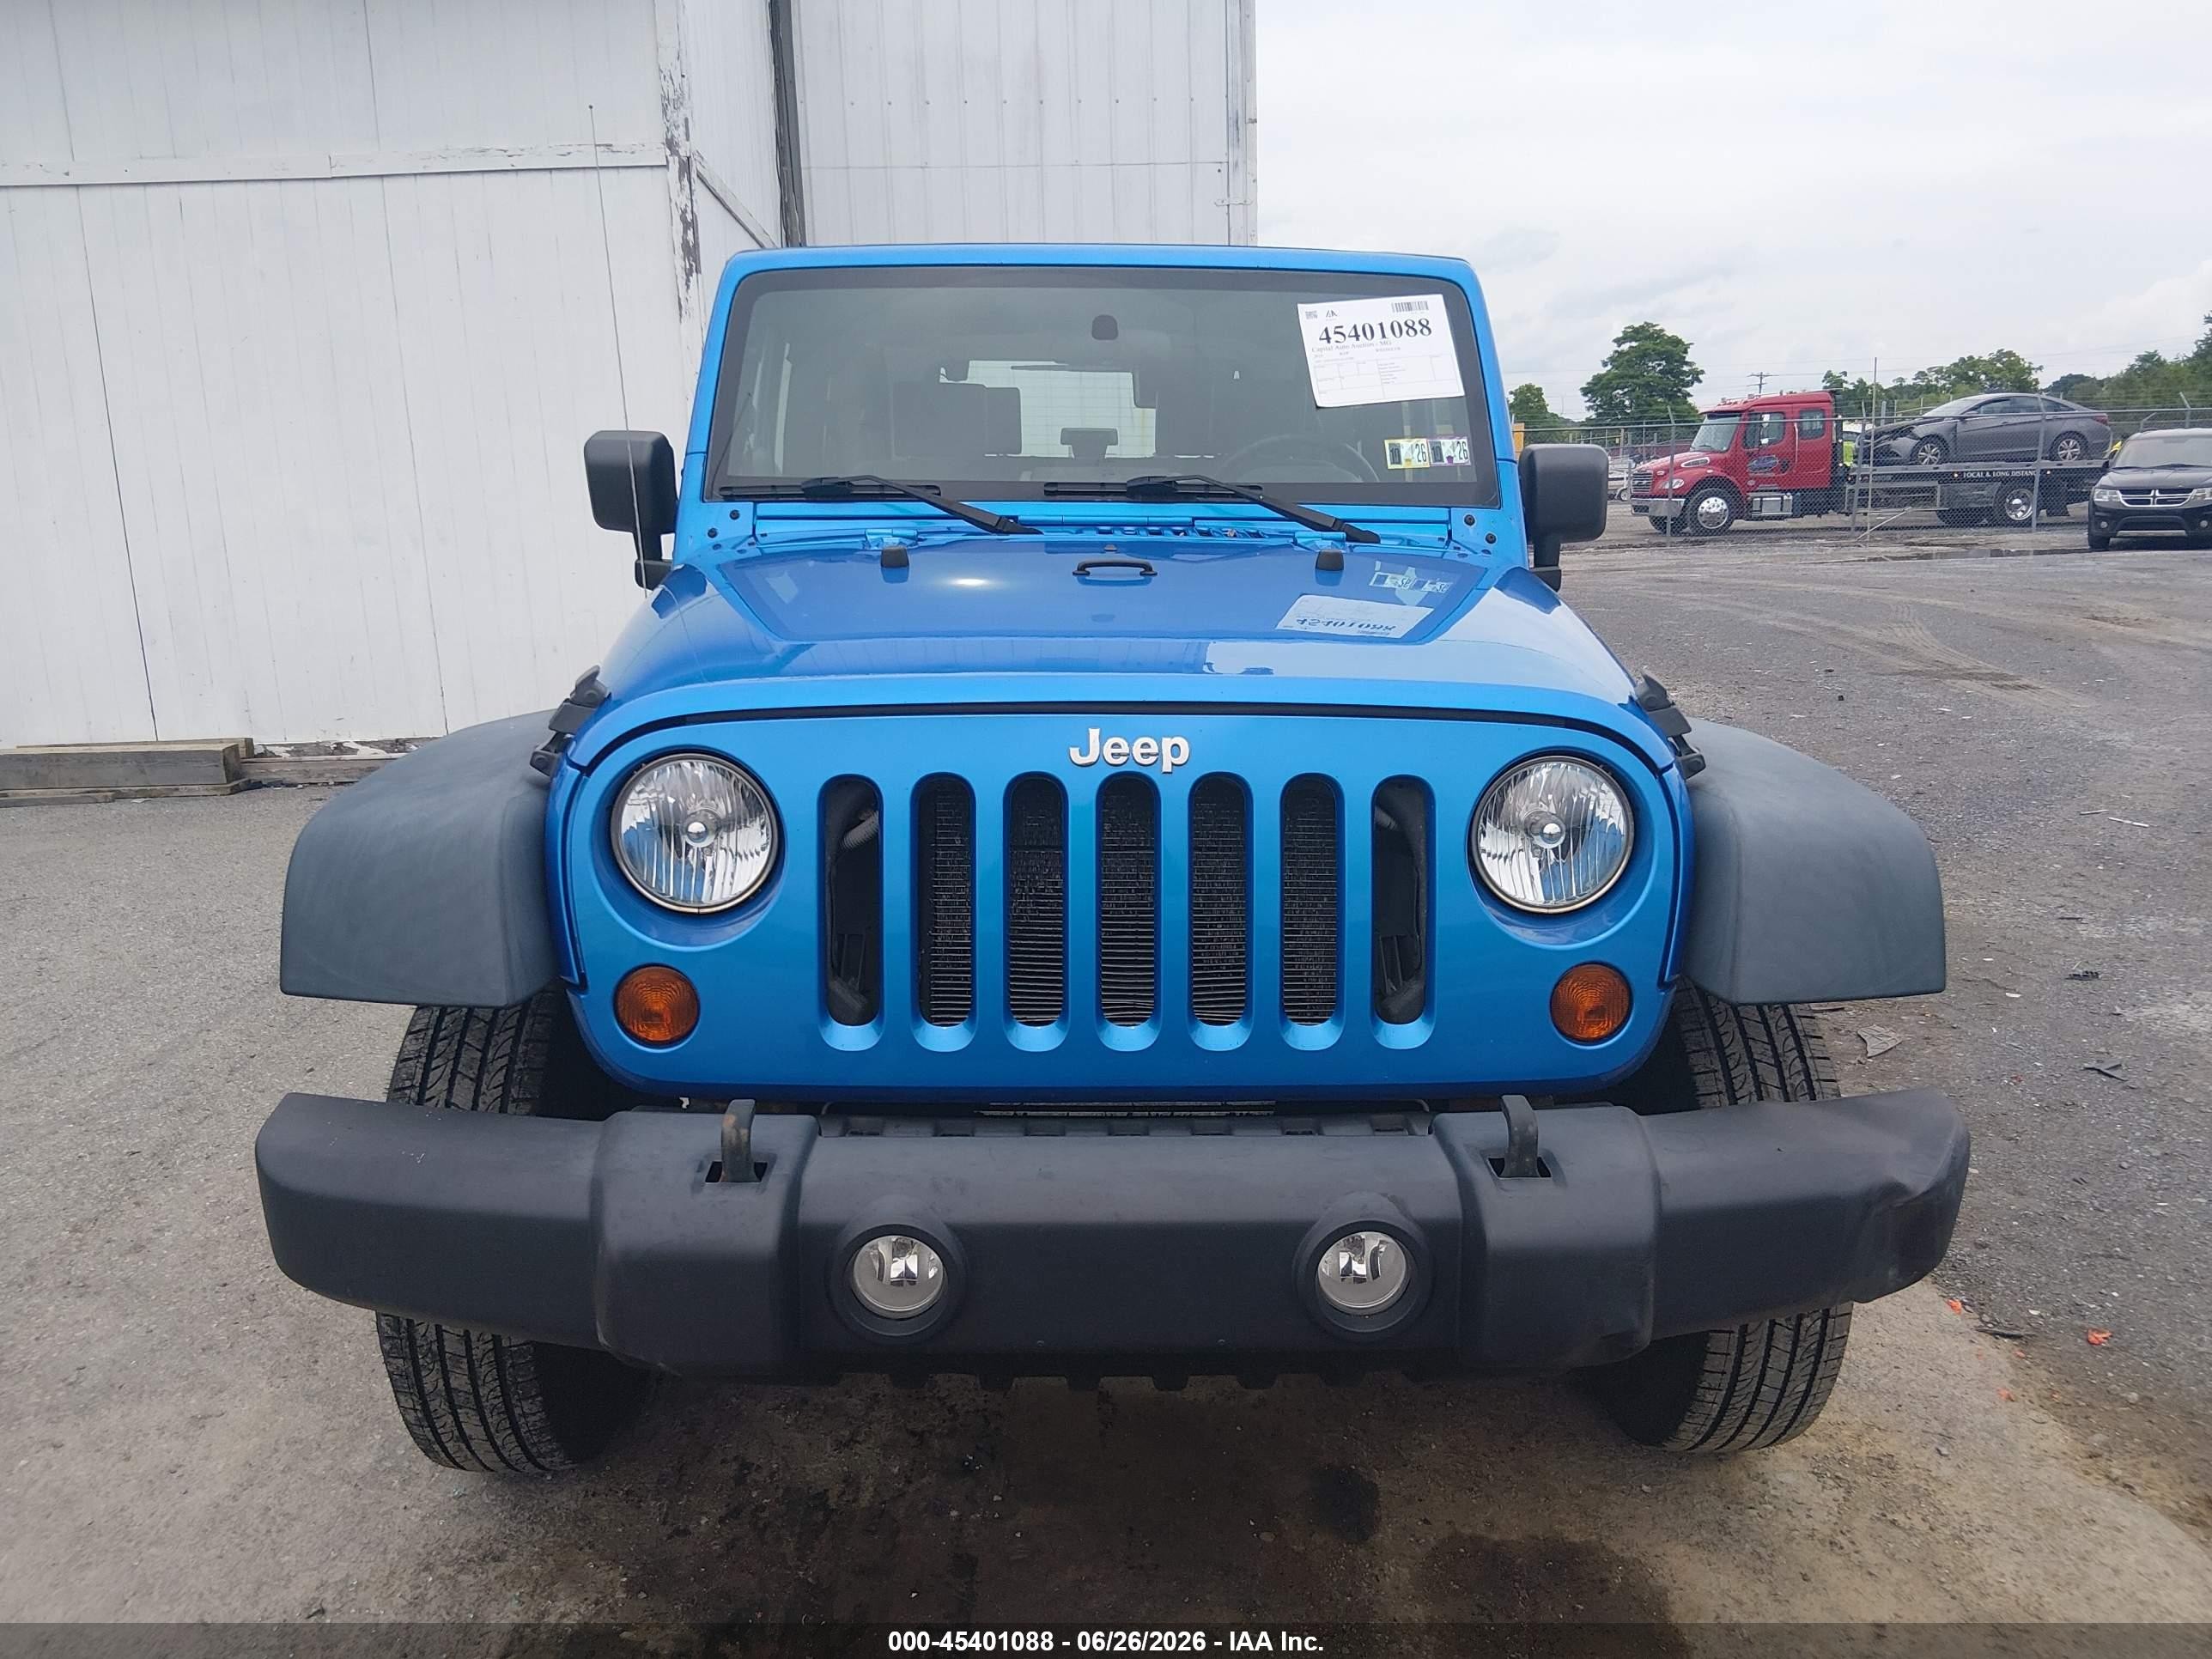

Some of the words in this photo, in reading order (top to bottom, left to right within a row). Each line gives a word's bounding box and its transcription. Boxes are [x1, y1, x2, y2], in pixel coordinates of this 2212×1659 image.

[1319, 318, 1432, 344] 45401088
[1415, 444, 1427, 462] 26
[1457, 441, 1468, 461] 26
[1069, 728, 1190, 774] Jeep
